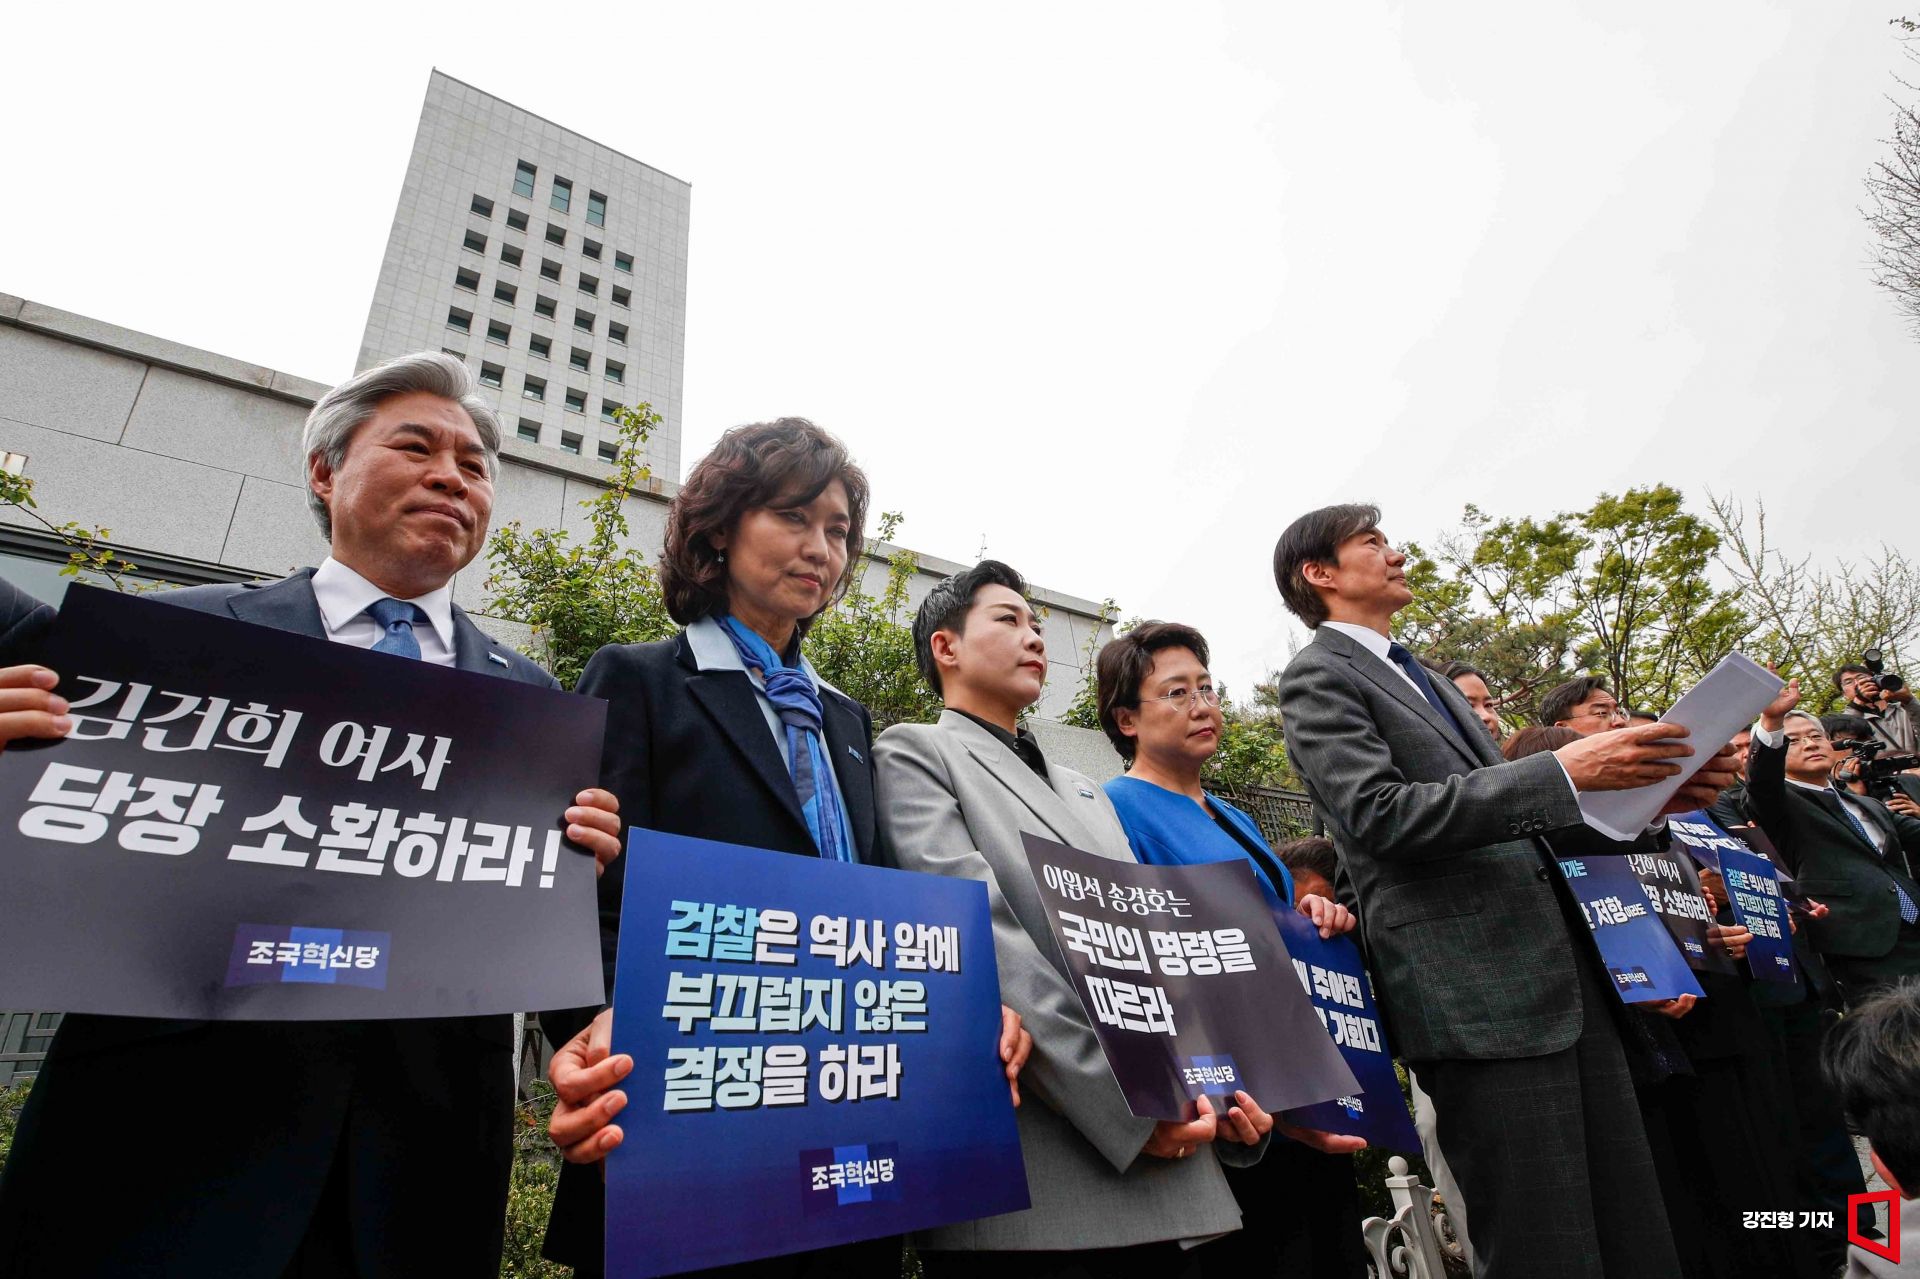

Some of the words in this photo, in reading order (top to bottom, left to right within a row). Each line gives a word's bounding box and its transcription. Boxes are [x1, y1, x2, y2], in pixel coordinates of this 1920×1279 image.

[64, 675, 303, 769] 김건희
[318, 720, 453, 791] 여사
[18, 762, 225, 856] 당장
[227, 795, 562, 889] 소환하라!
[1043, 863, 1106, 908] 이원석
[1108, 882, 1192, 918] 송경호는
[1657, 858, 1682, 884] 여사
[1726, 868, 1751, 891] 검찰은
[1748, 873, 1766, 894] 역사
[1663, 888, 1713, 923] 소환하라!
[247, 940, 380, 970] 조국혁신당
[665, 900, 799, 964] 검찰은
[810, 914, 887, 968] 역사
[894, 922, 960, 972] 앞에
[1058, 910, 1152, 975] 국민의
[1148, 928, 1257, 976] 명령을
[1310, 964, 1365, 1010] 주어진
[1615, 972, 1648, 984] 조국혁신당
[662, 971, 842, 1033] 부끄럽지
[854, 980, 927, 1032] 않은
[1084, 974, 1178, 1037] 따르라
[1329, 1009, 1382, 1053] 기회다
[664, 1044, 808, 1111] 결정을
[819, 1043, 901, 1102] 하라
[1183, 1066, 1236, 1085] 조국혁신당
[811, 1158, 895, 1191] 조국혁신당
